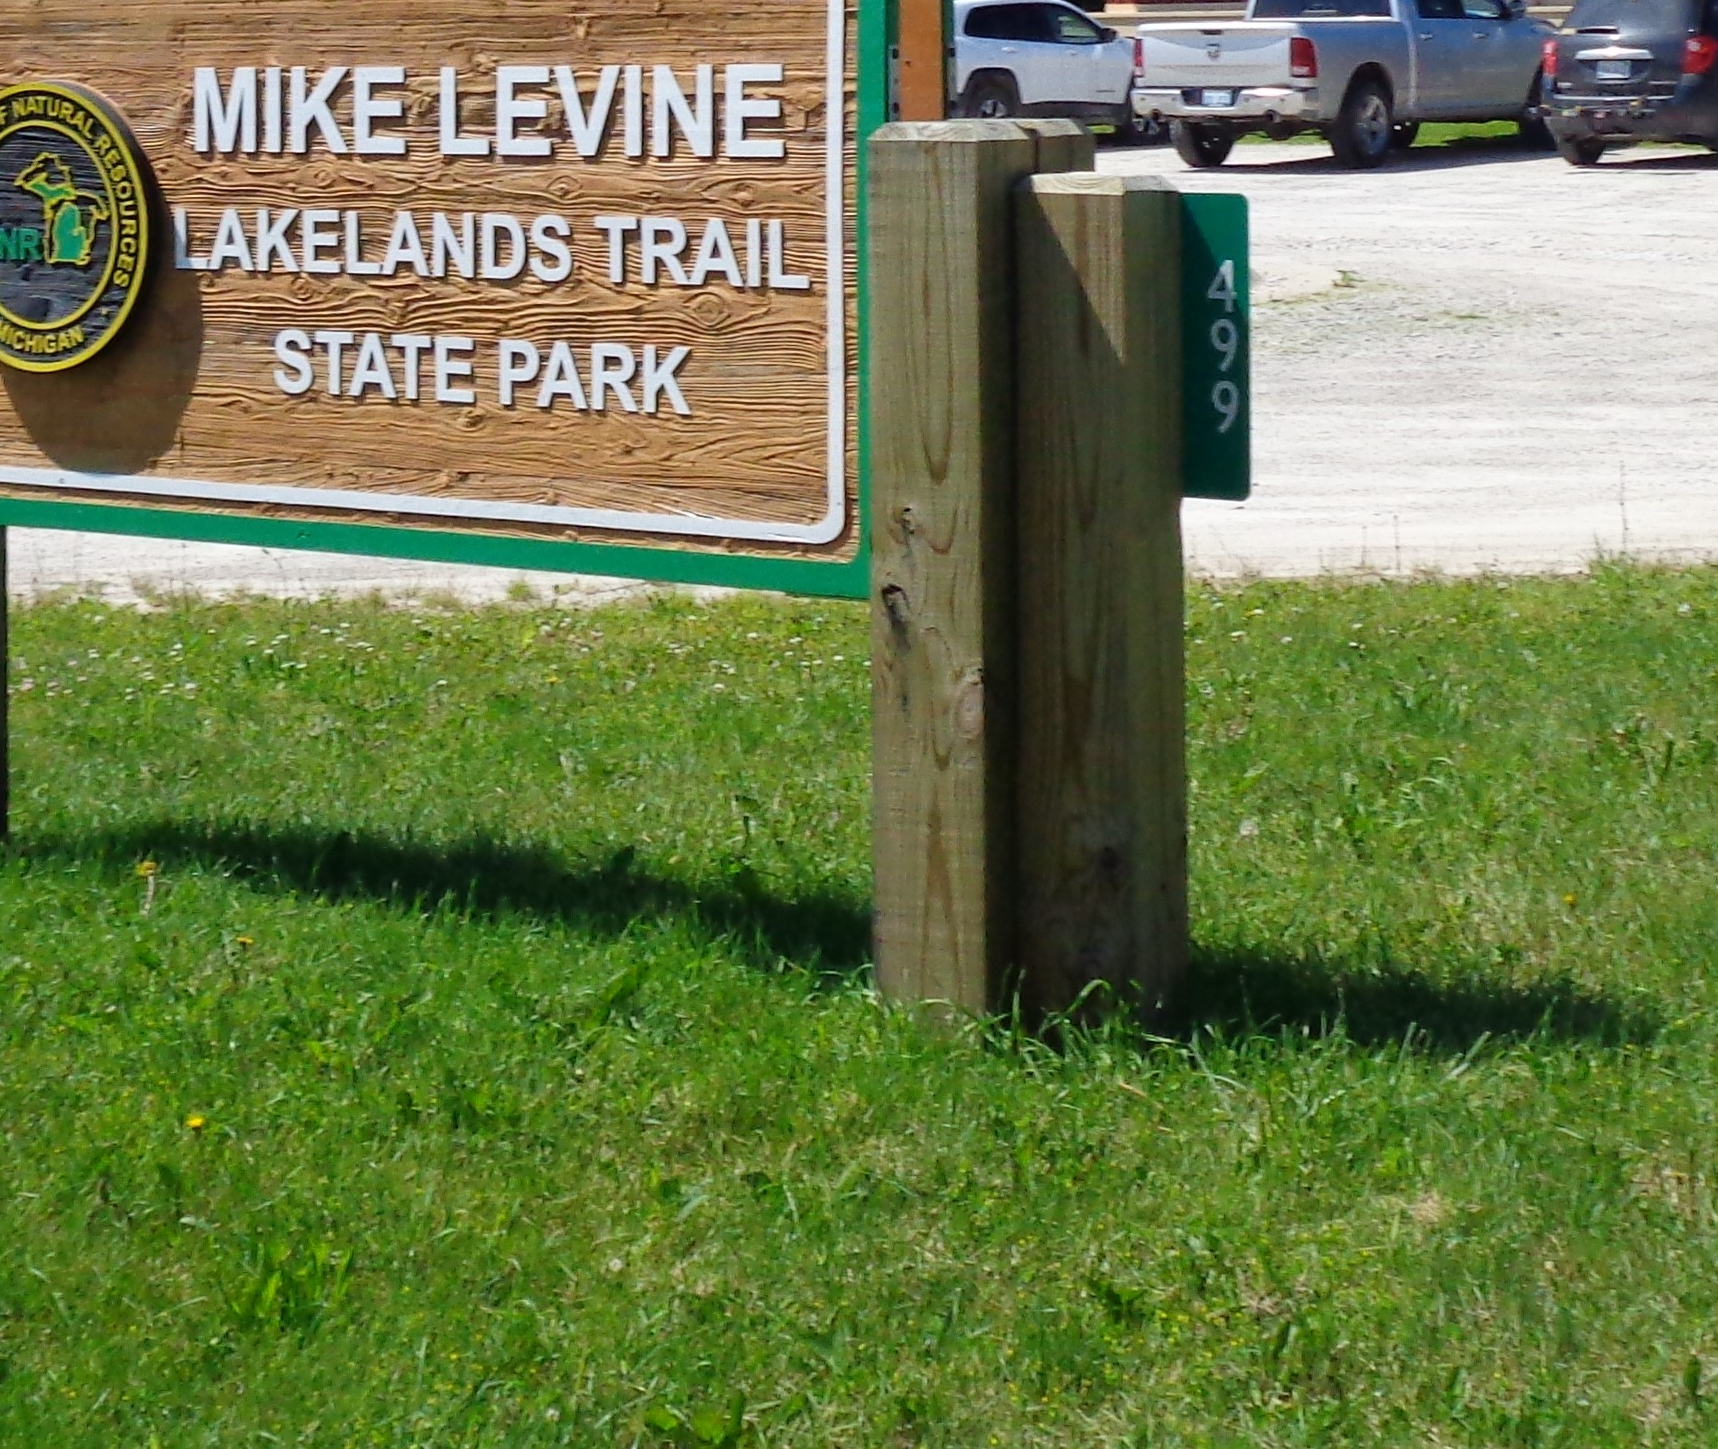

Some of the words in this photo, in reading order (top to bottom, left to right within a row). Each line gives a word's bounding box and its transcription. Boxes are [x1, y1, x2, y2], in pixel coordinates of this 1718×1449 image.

[193, 66, 407, 155] MIKE
[441, 63, 786, 158] LEVINE
[12, 96, 96, 139] NATURAL
[94, 136, 138, 287] RESOURCES
[175, 208, 573, 283] LAKELANDS
[595, 216, 811, 289] TRAIL
[273, 328, 476, 404] STATE
[498, 339, 693, 416] PARK
[1207, 259, 1240, 433] 499
